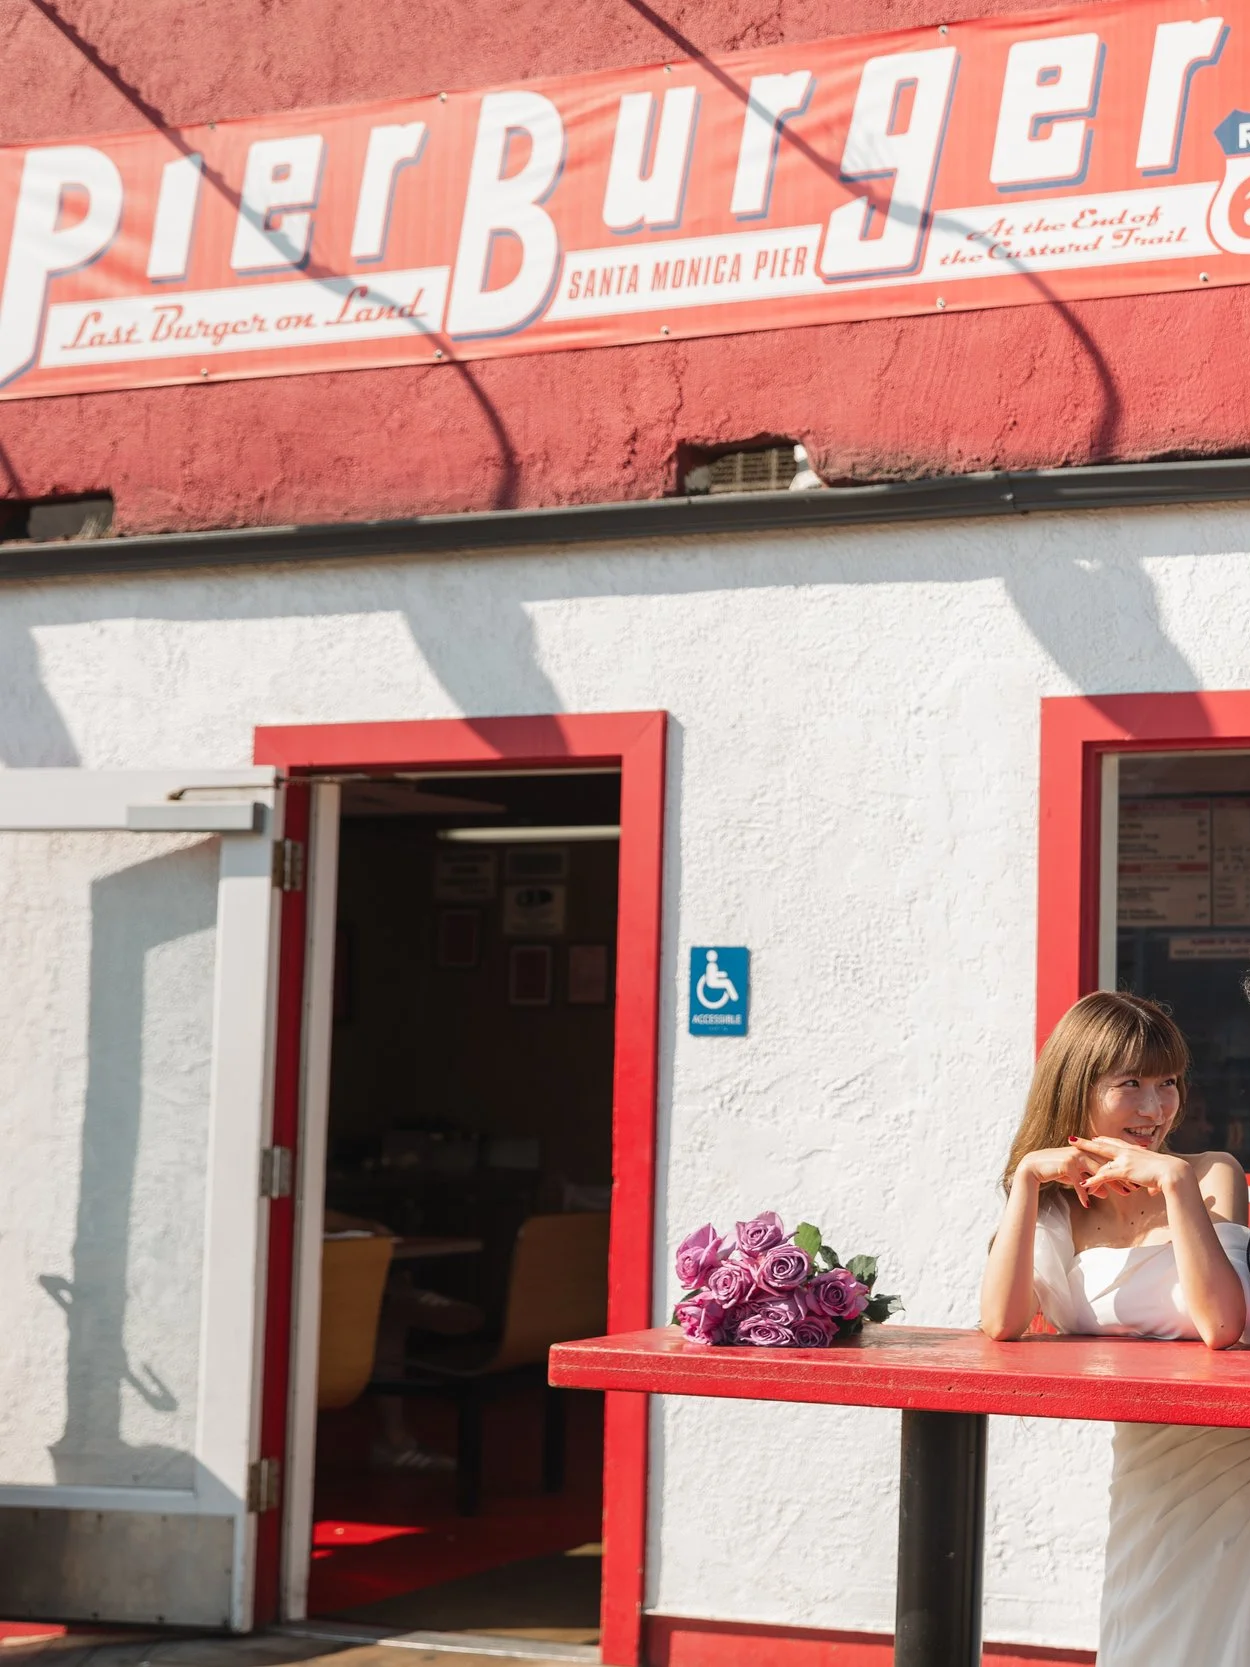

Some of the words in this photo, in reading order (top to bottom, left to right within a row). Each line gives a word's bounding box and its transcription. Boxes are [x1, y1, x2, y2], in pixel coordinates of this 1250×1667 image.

[446, 16, 1230, 341] Burger
[939, 249, 983, 266] the
[987, 235, 1103, 260] Custard
[1111, 226, 1188, 249] Trail
[966, 217, 1014, 241] At
[1022, 217, 1066, 233] the
[1071, 208, 1129, 229] End
[1130, 206, 1163, 226] of
[568, 264, 639, 300] SANTA
[651, 253, 742, 291] MONICA
[754, 246, 808, 280] PIER
[60, 311, 143, 350] Last
[150, 304, 268, 346] Burger
[273, 312, 315, 330] on
[324, 285, 428, 326] Land
